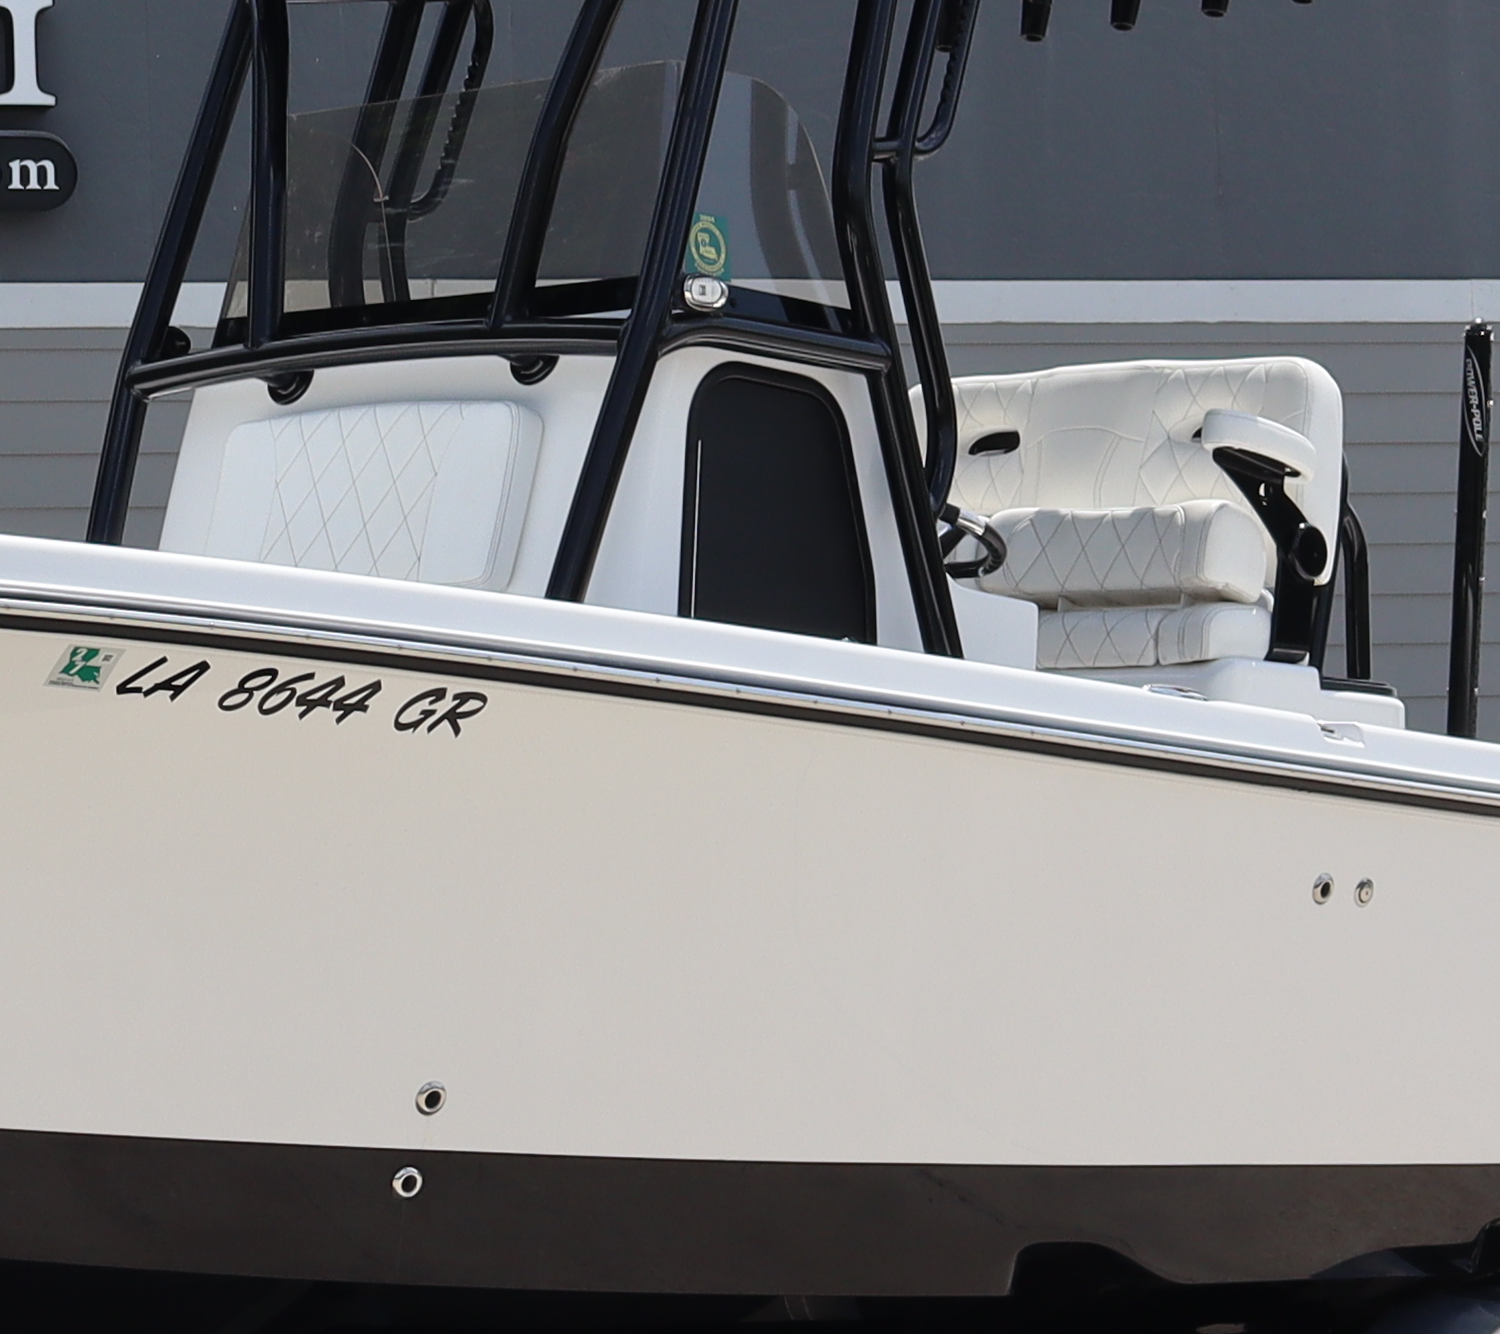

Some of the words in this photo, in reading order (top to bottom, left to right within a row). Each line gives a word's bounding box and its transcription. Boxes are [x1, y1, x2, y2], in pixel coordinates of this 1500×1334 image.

[1465, 358, 1484, 442] POWER-POLE
[115, 655, 212, 702] LA
[217, 666, 382, 726] 8644
[393, 686, 489, 738] GR
